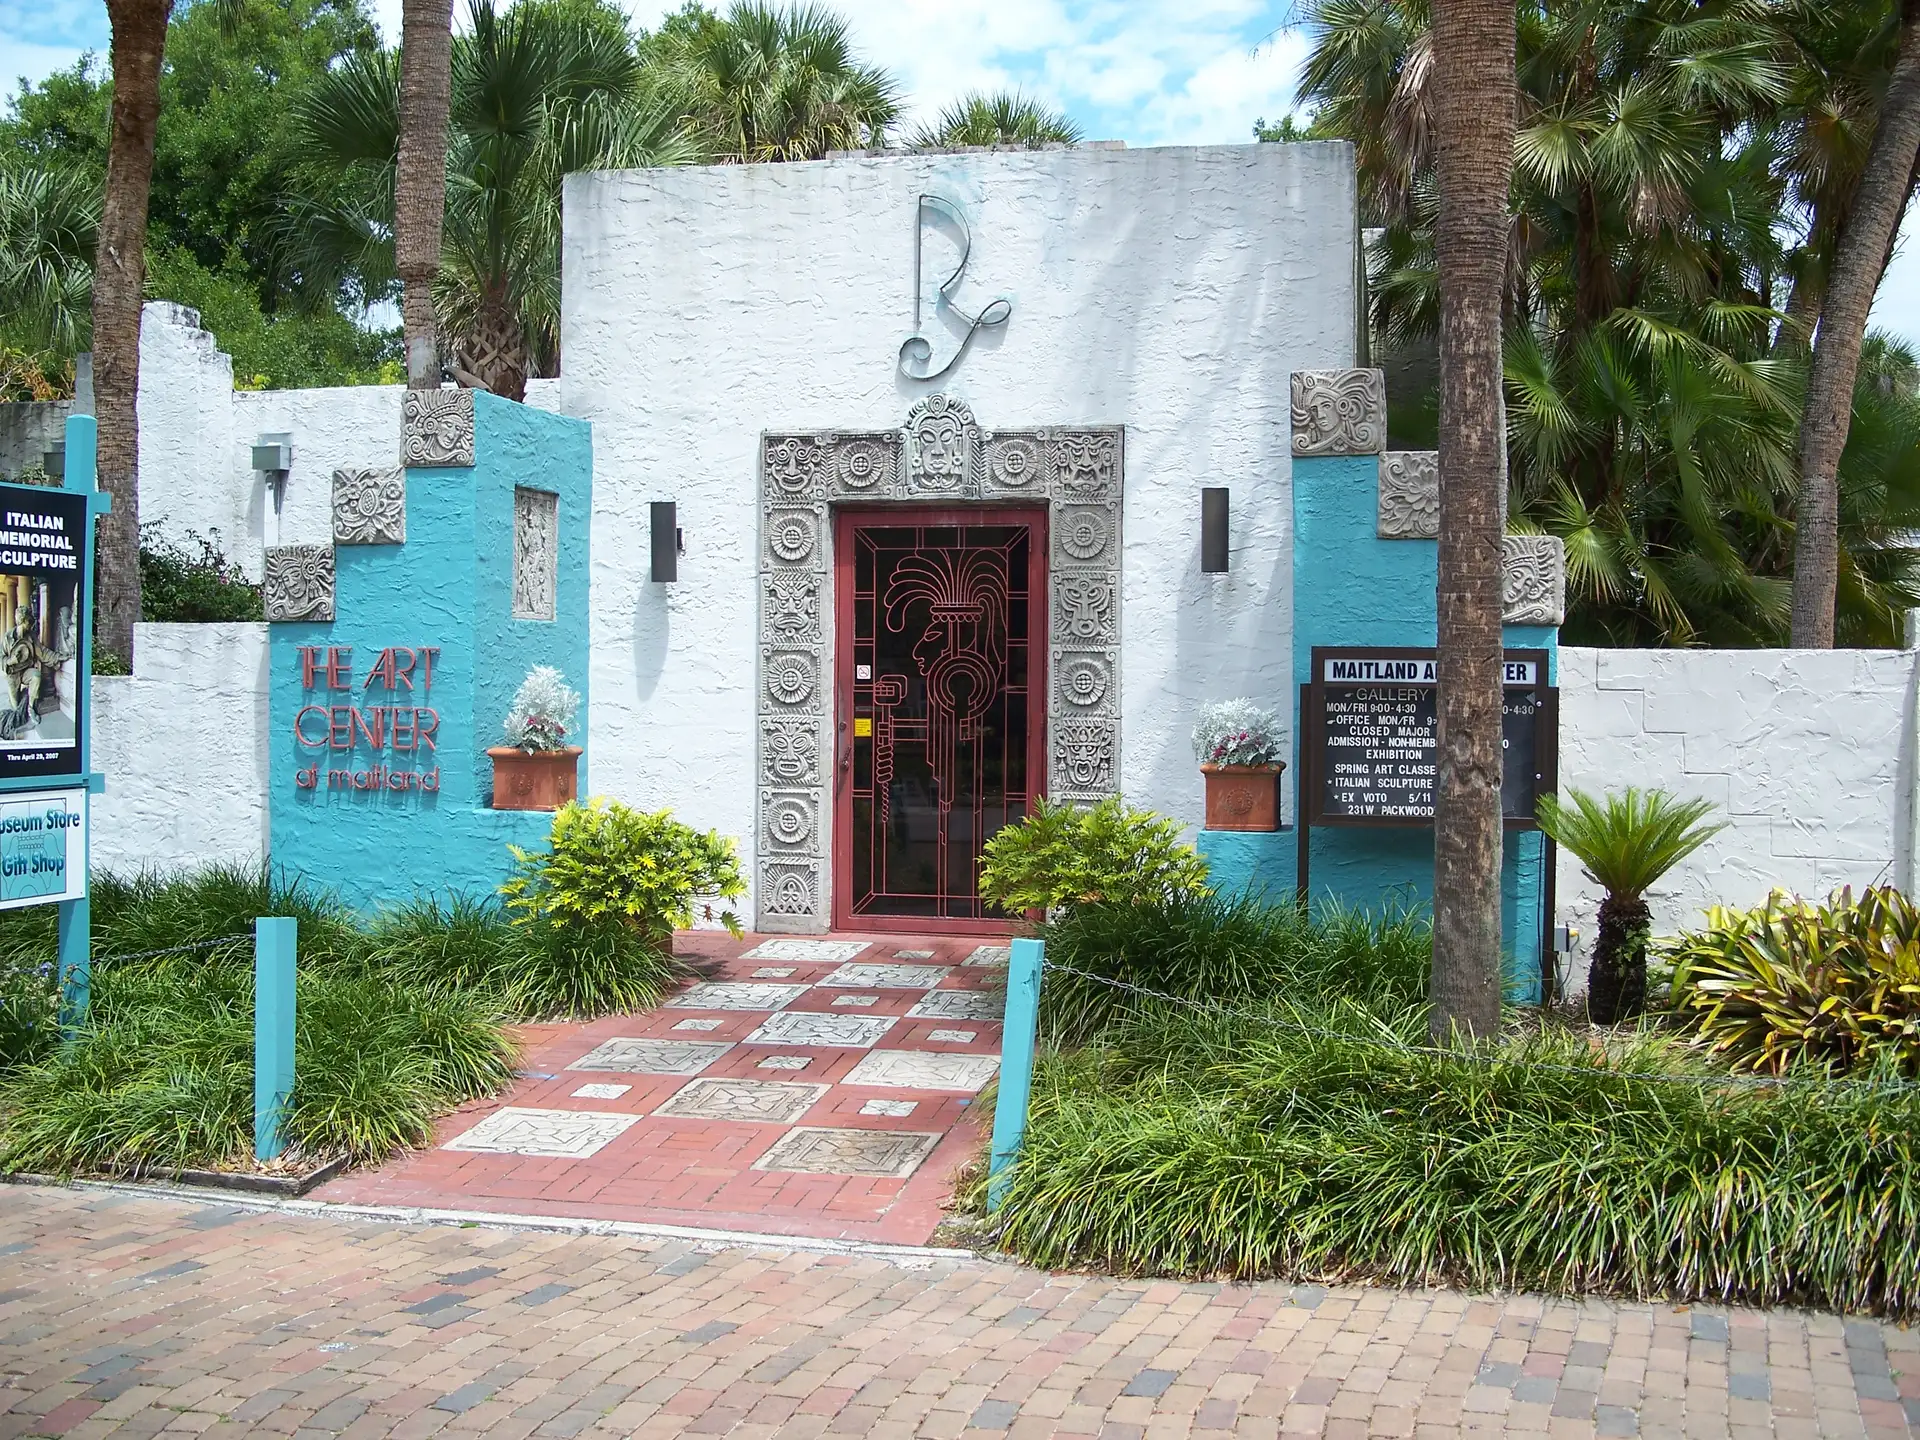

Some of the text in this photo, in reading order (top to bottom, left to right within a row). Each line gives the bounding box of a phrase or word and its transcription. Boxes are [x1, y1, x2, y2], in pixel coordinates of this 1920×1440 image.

[7, 511, 64, 531] ITALIAN
[0, 550, 77, 569] CULPTURE
[296, 646, 440, 690] THE ART
[1333, 662, 1418, 679] MAITLAND
[1356, 688, 1429, 701] GALLERY
[1326, 702, 1368, 713] MON/FRI
[1336, 715, 1370, 725] OFFICE
[1378, 715, 1416, 726] MON/FR
[295, 705, 441, 750] CENTER
[1349, 726, 1430, 737] CLOSED MAJOR
[1327, 737, 1379, 747] ADMISSION
[1388, 738, 1437, 748] NON-MEMB
[22, 753, 35, 761] April
[36, 753, 45, 761] 29,
[45, 752, 59, 760] 2007
[1366, 749, 1422, 760] EXHIBITION
[1334, 764, 1436, 775] SPRING ART CLASSE
[296, 762, 441, 791] at maitland
[1335, 778, 1433, 789] ITALIAN SCULPTURE
[1341, 793, 1431, 804] EX VOTO 5/11
[1381, 806, 1434, 816] PACKWOOD
[0, 808, 80, 834] useum Store
[2, 851, 64, 877] Gift Shop
